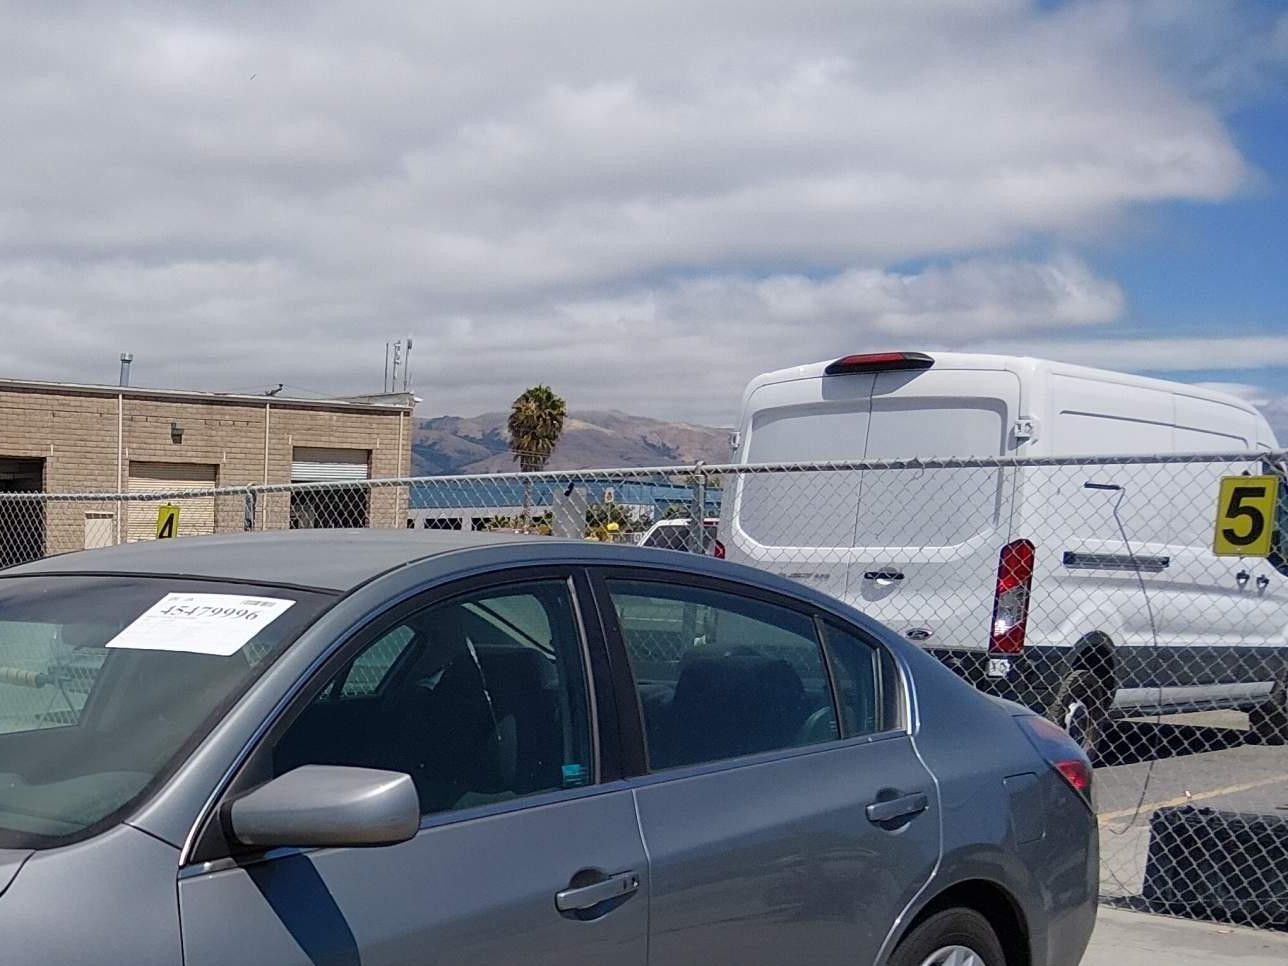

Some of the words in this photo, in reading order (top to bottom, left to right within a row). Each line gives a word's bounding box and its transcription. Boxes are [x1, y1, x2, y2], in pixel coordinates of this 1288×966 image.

[158, 512, 175, 539] 4
[1222, 486, 1266, 546] 5
[160, 605, 261, 621] 45479996
